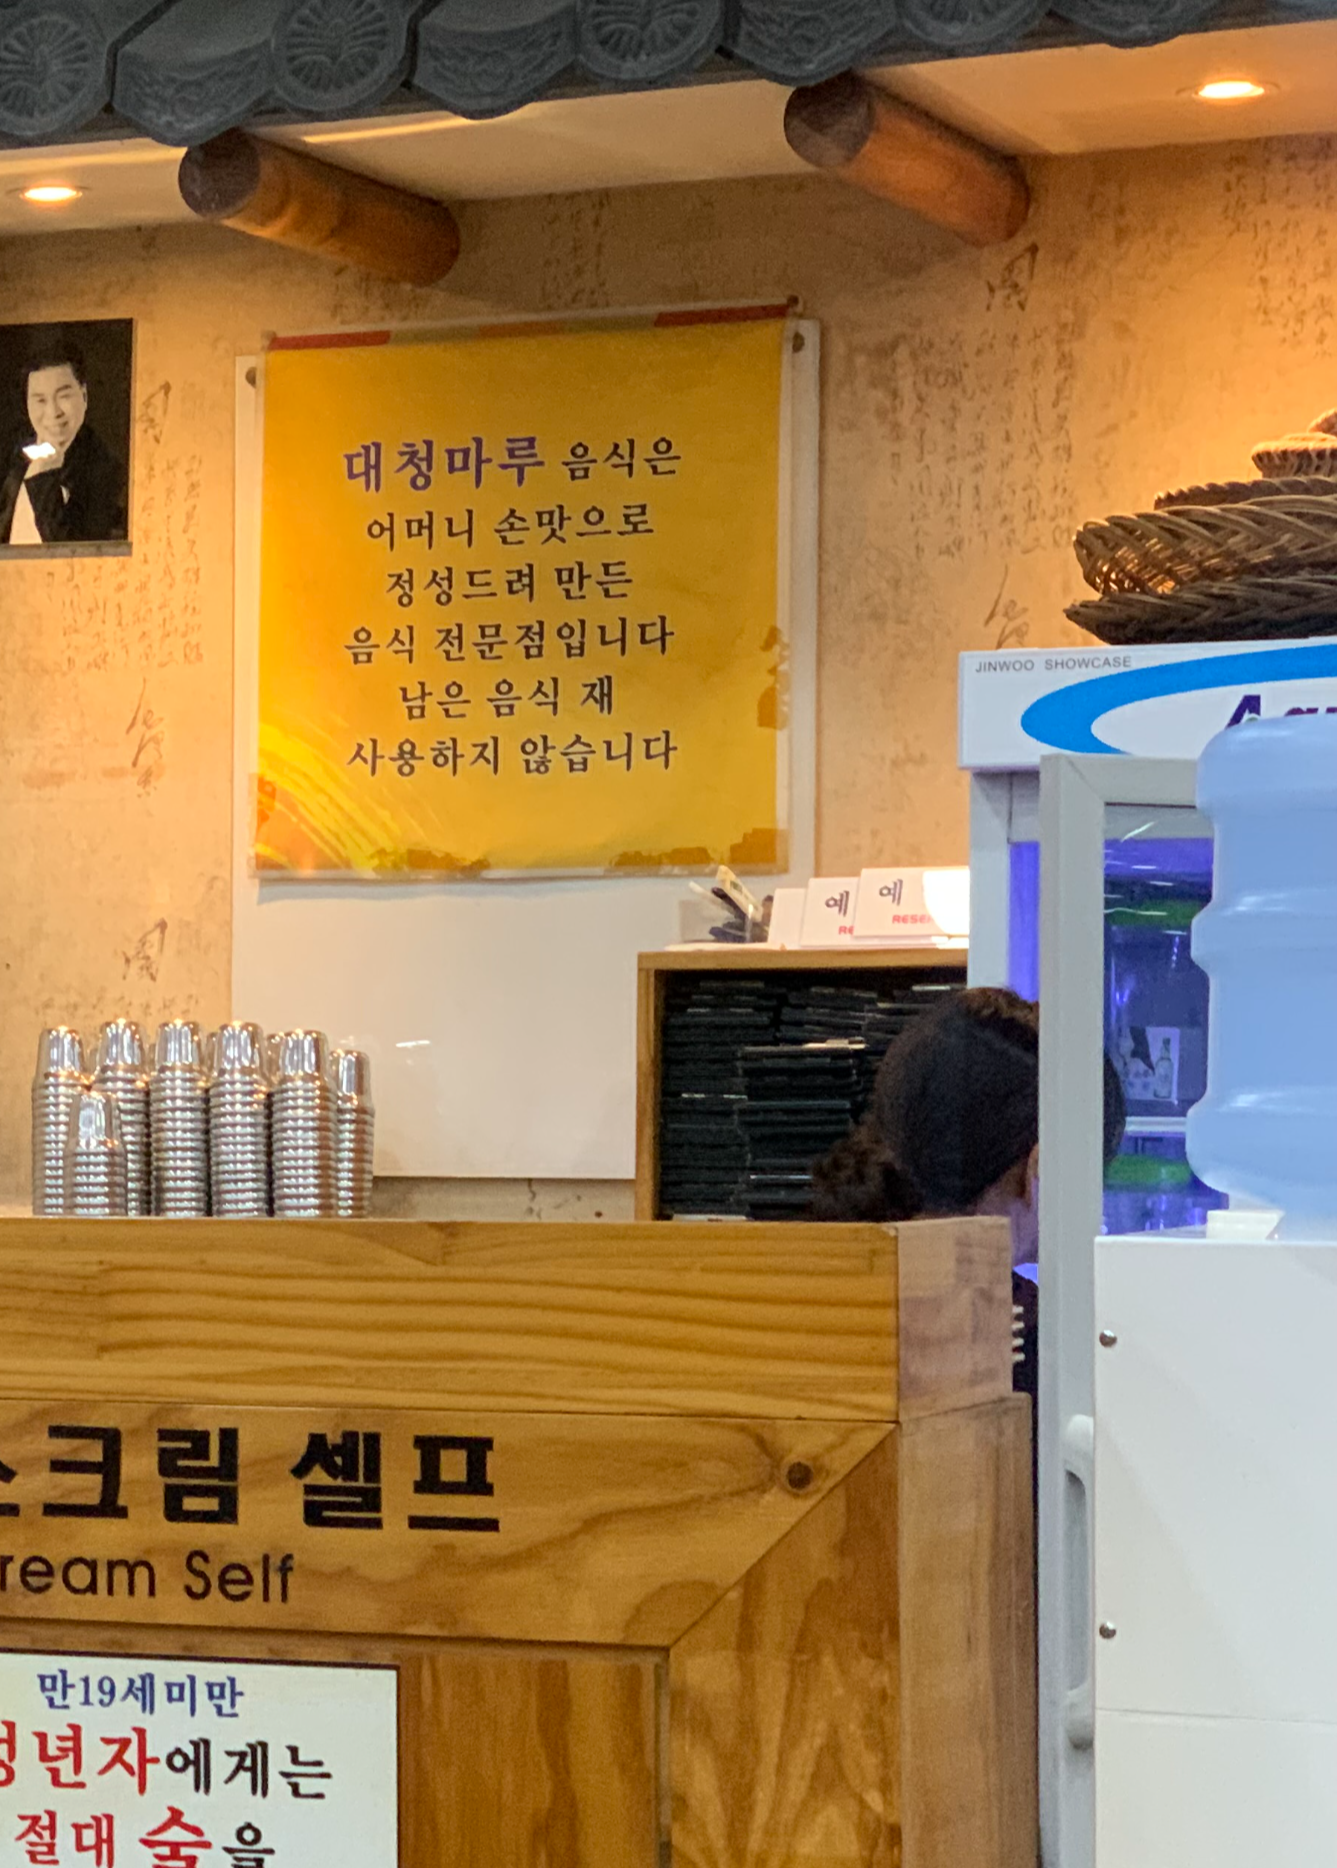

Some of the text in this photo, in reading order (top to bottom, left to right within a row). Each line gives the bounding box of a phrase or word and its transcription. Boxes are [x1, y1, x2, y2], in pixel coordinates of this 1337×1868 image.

[343, 435, 682, 494] 대청마루 음식은
[366, 503, 655, 552] 어머니 손맛으로
[385, 560, 633, 609] 정성드려 만든
[343, 614, 675, 665] 음식 전문점입니다
[975, 655, 1132, 673] JINWOO SHOWCASE
[398, 674, 613, 721] 남은 음식 재
[346, 729, 678, 778] 사용하지 않습니다
[825, 889, 850, 917] 예
[878, 878, 903, 907] 예
[289, 1430, 501, 1533] 셀프
[184, 1550, 295, 1604] Self
[37, 1668, 245, 1718] 만19세미만
[14, 1808, 116, 1868] 절대
